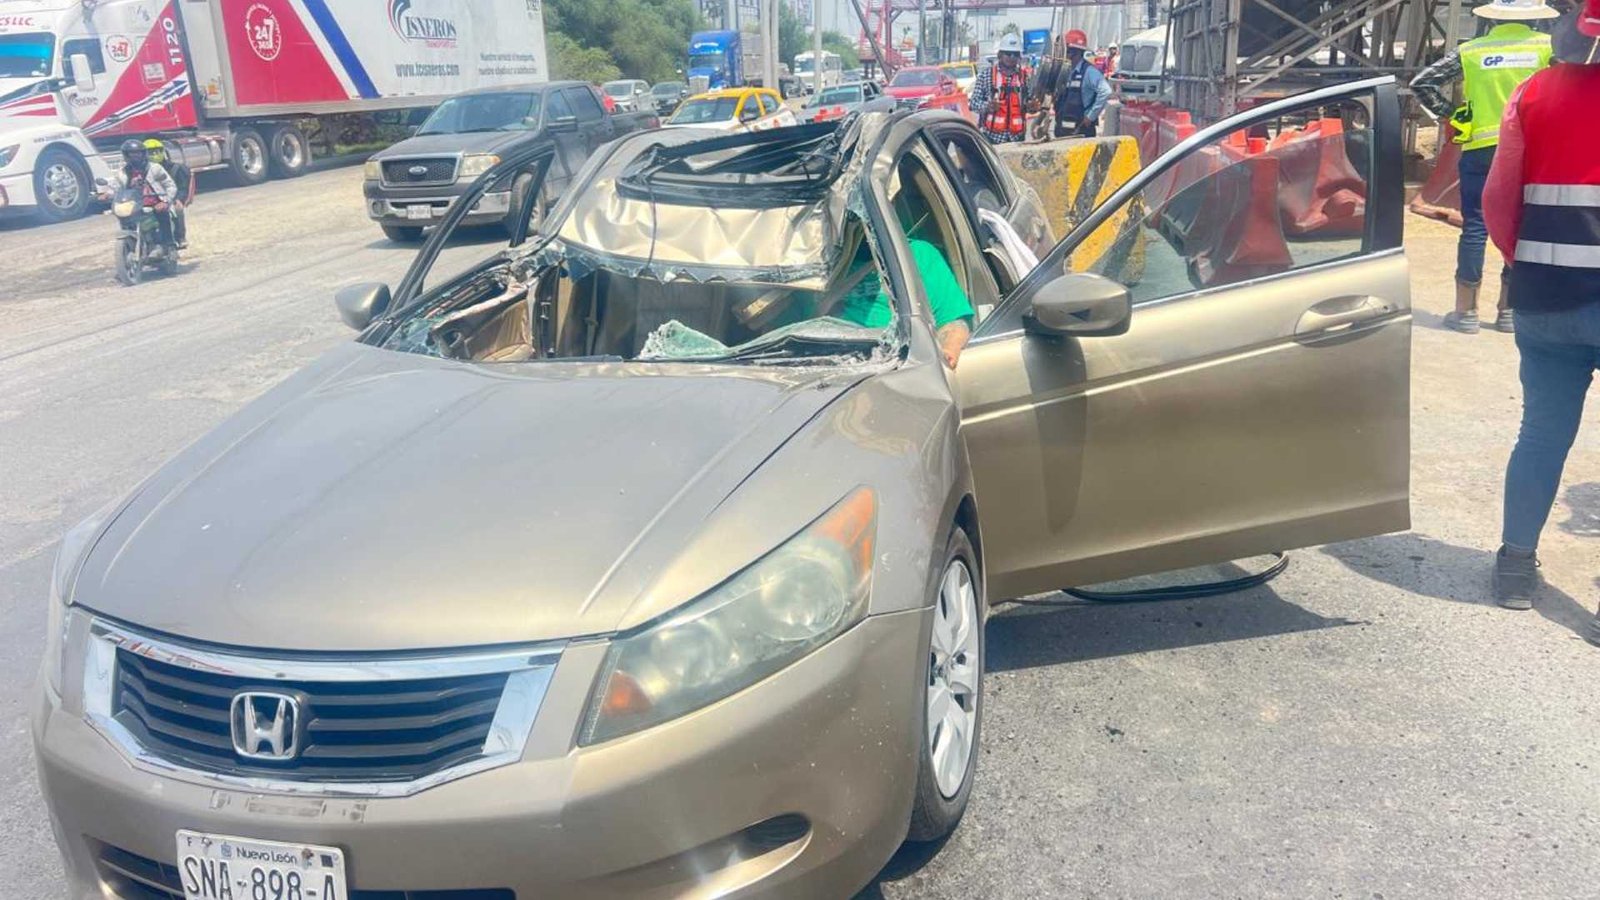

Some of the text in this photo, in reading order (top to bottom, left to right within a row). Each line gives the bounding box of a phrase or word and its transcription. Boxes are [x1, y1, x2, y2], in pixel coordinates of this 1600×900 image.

[163, 17, 183, 66] 1120
[1484, 55, 1504, 66] GP
[236, 847, 298, 864] Nuevo León
